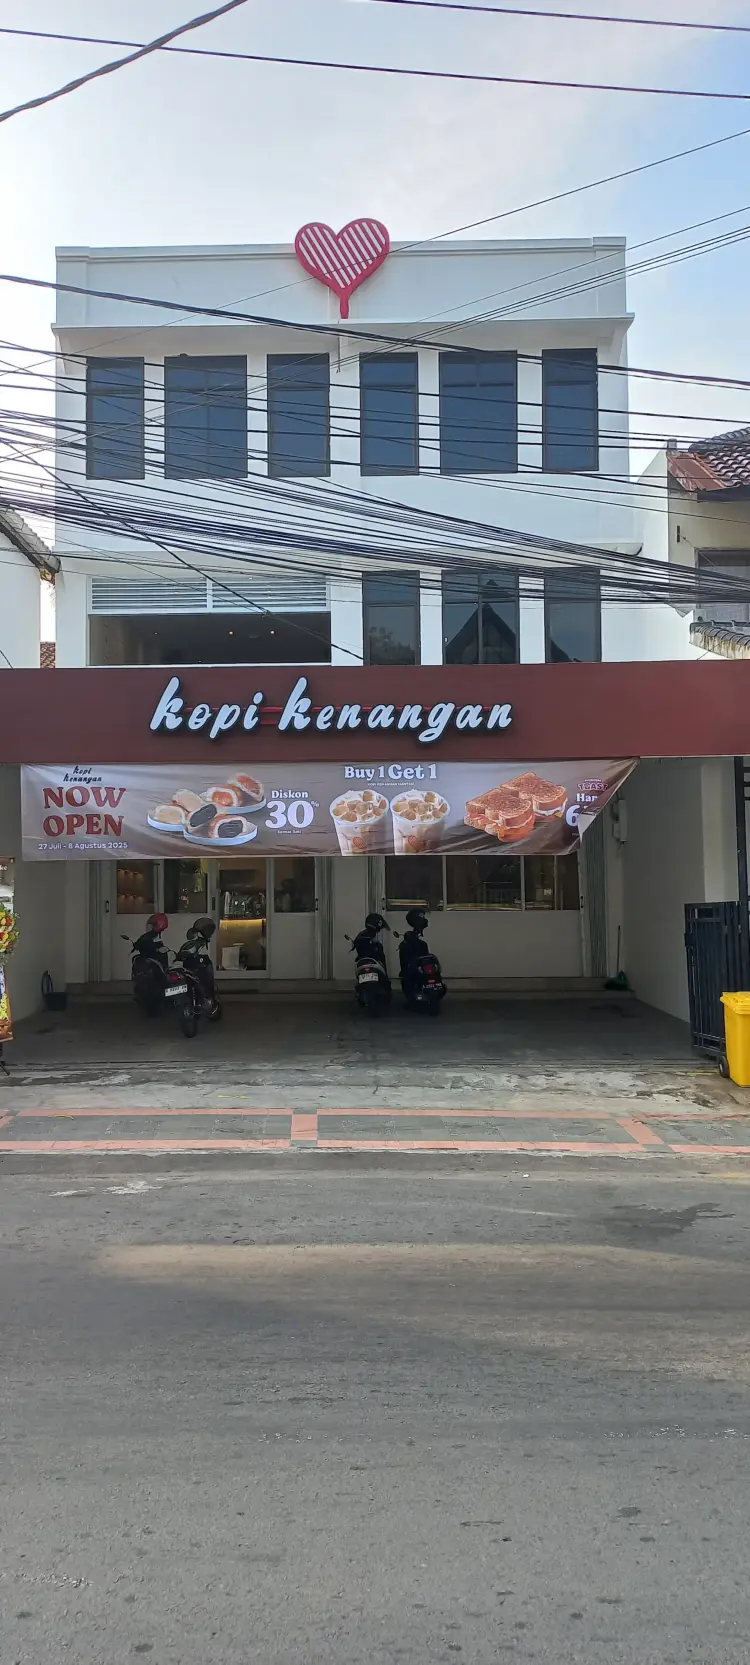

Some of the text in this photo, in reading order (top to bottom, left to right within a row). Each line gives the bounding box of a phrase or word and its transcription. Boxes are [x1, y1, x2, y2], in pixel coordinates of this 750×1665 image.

[149, 676, 512, 742] kopi kenangan
[73, 765, 92, 776] kopi
[344, 763, 437, 781] Buy 1 Get 1
[63, 773, 102, 784] kenangan
[43, 786, 127, 809] NOW
[271, 789, 309, 799] Diskon
[43, 814, 125, 837] OPEN
[74, 843, 107, 851] Agustus
